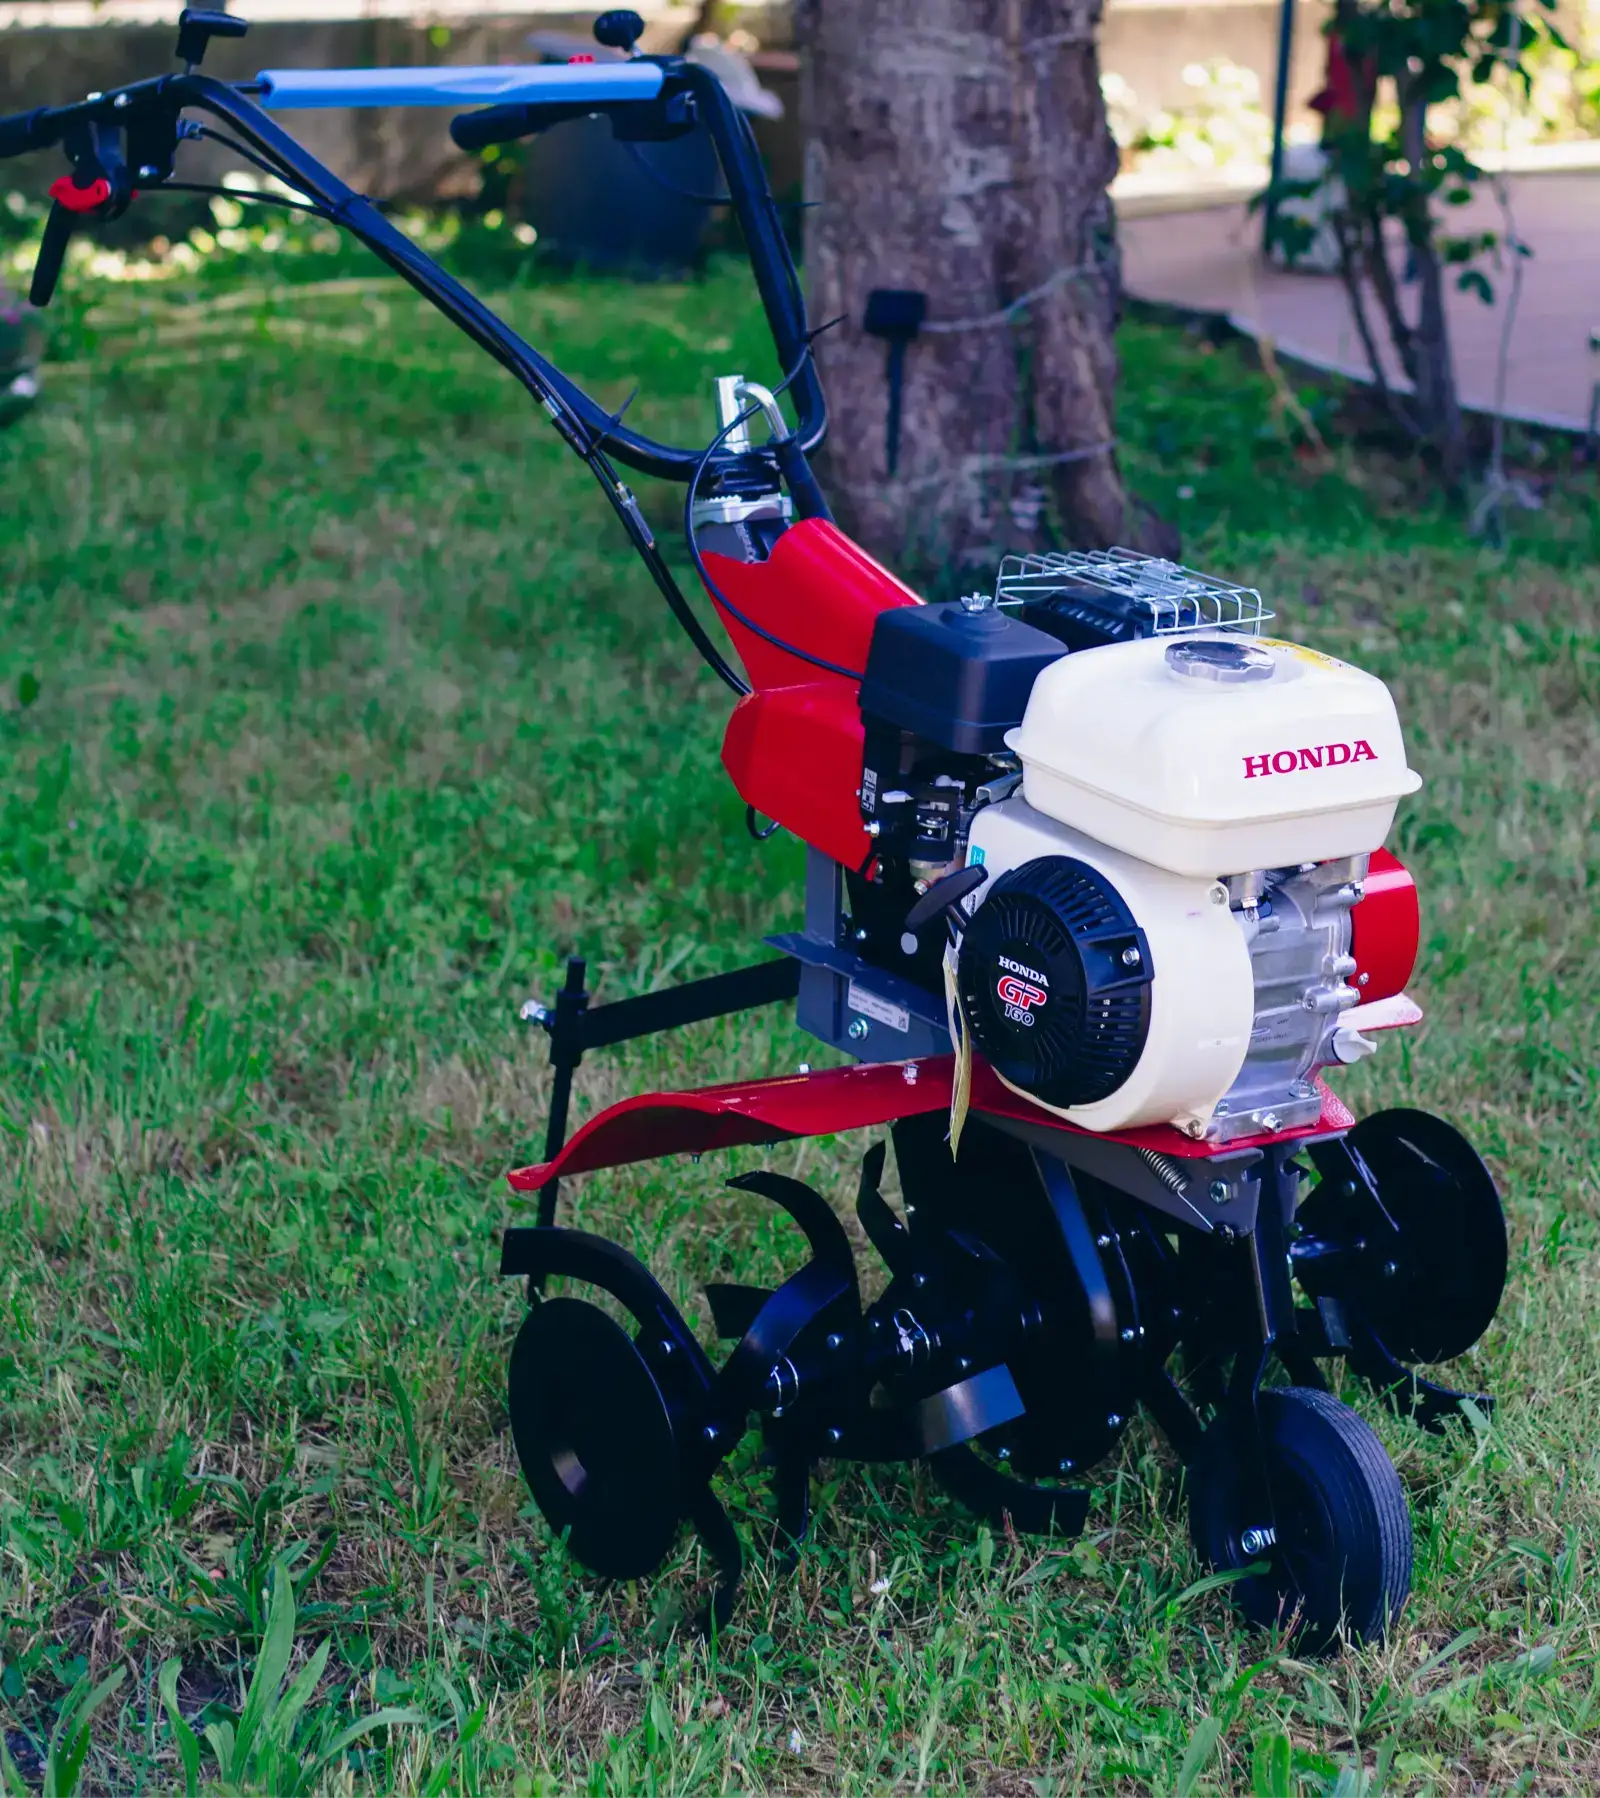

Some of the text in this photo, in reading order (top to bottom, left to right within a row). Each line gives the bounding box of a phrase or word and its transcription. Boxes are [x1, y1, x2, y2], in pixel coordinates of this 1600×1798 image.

[1242, 740, 1378, 779] HONDA
[998, 955, 1049, 987] HONDA
[997, 975, 1047, 1010] GP
[1004, 1003, 1035, 1027] 160
